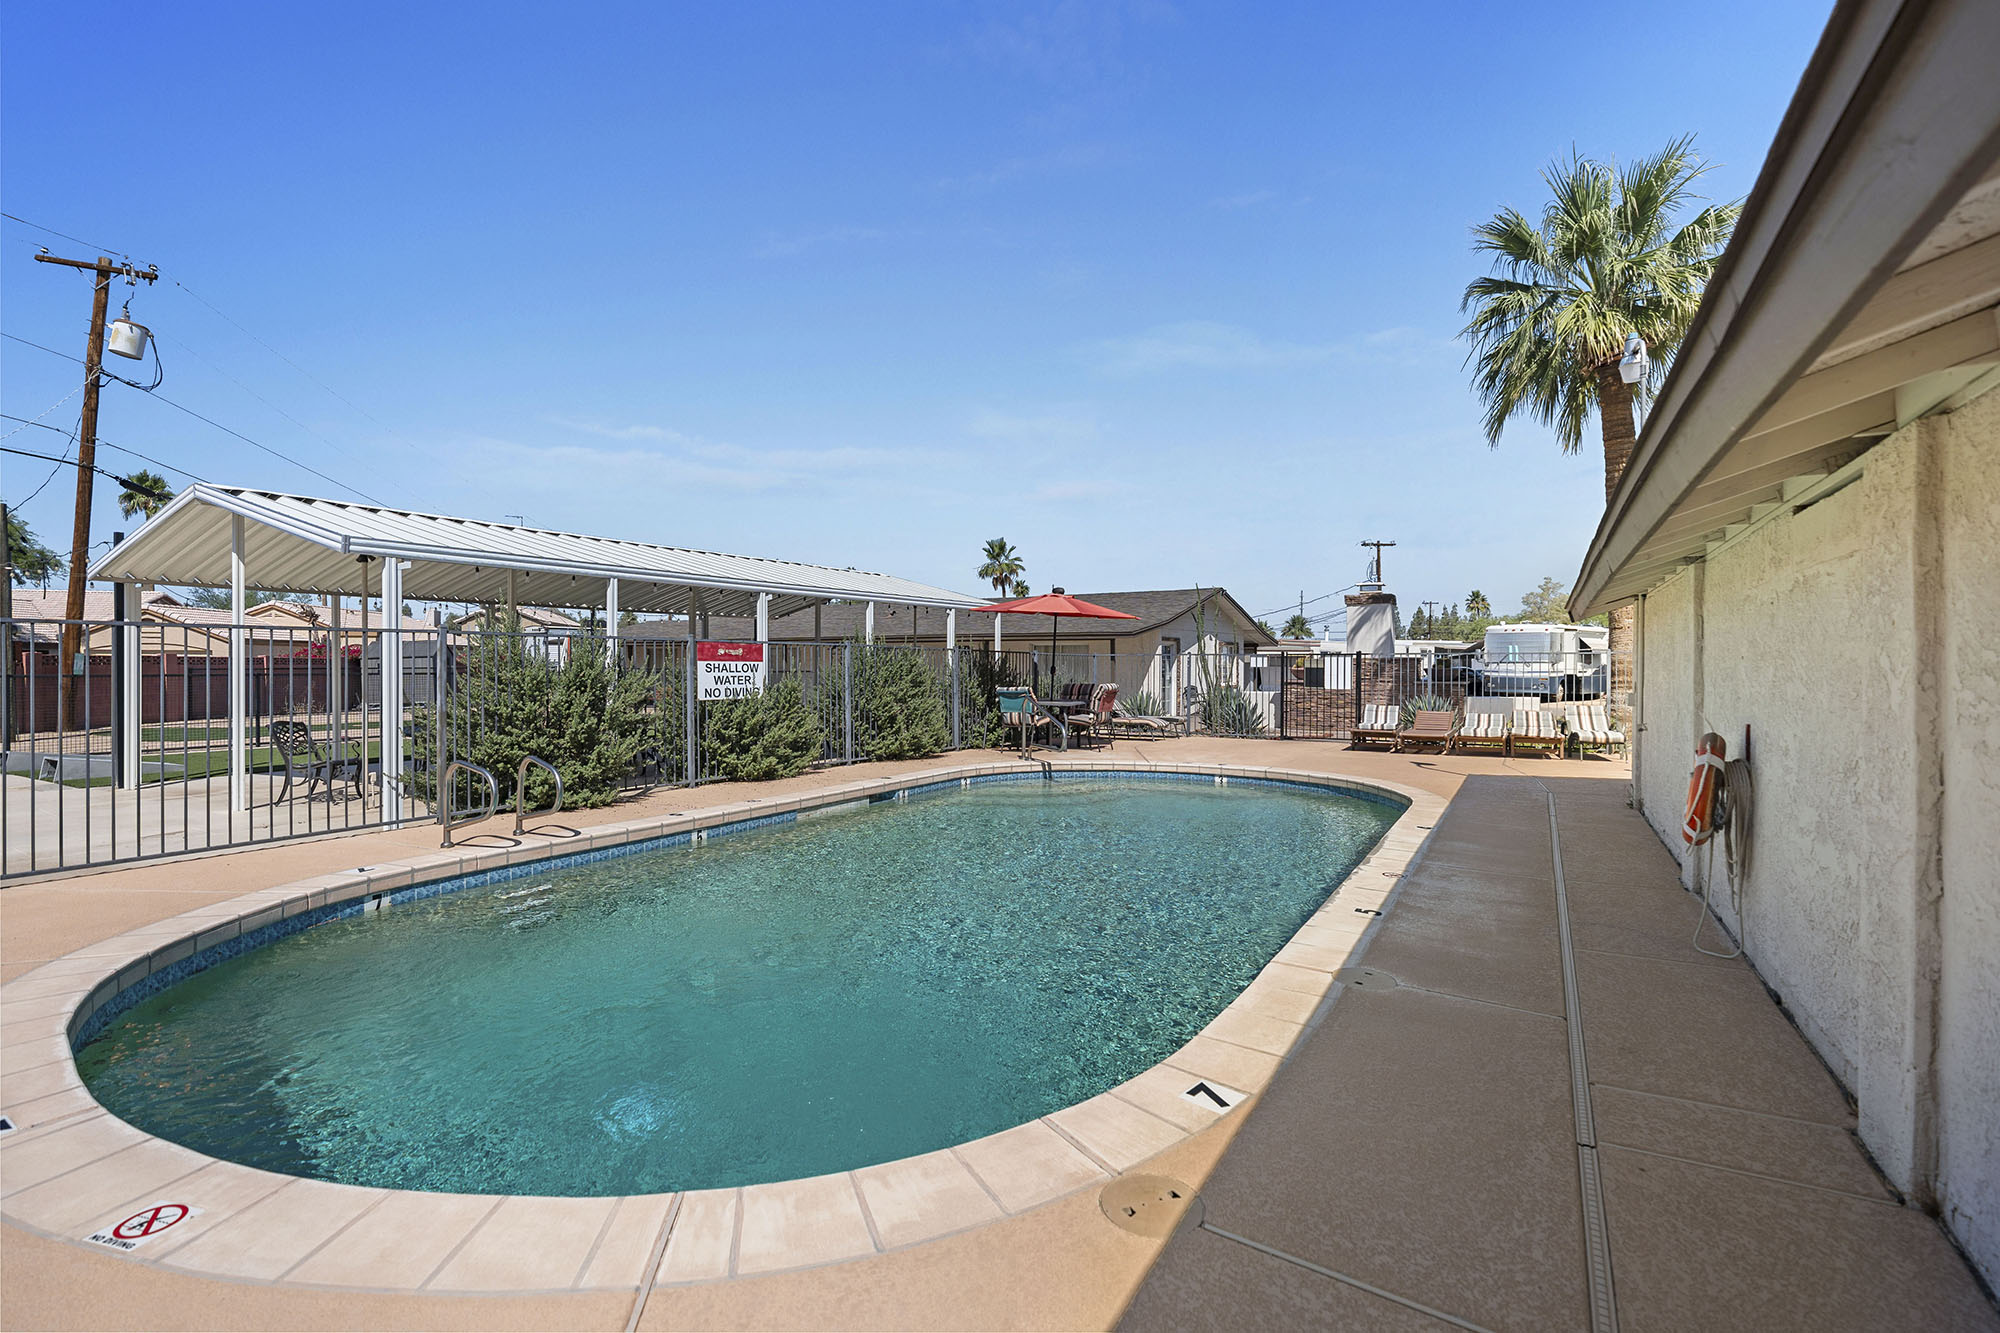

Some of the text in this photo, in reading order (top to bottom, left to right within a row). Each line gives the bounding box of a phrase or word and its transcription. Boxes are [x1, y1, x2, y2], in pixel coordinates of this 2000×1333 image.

[705, 663, 759, 673] SHALLOW
[713, 675, 752, 685] WATER
[704, 688, 721, 698] NO
[371, 893, 382, 911] 7
[1185, 1081, 1231, 1108] 7
[88, 1234, 136, 1250] NO DIVING
